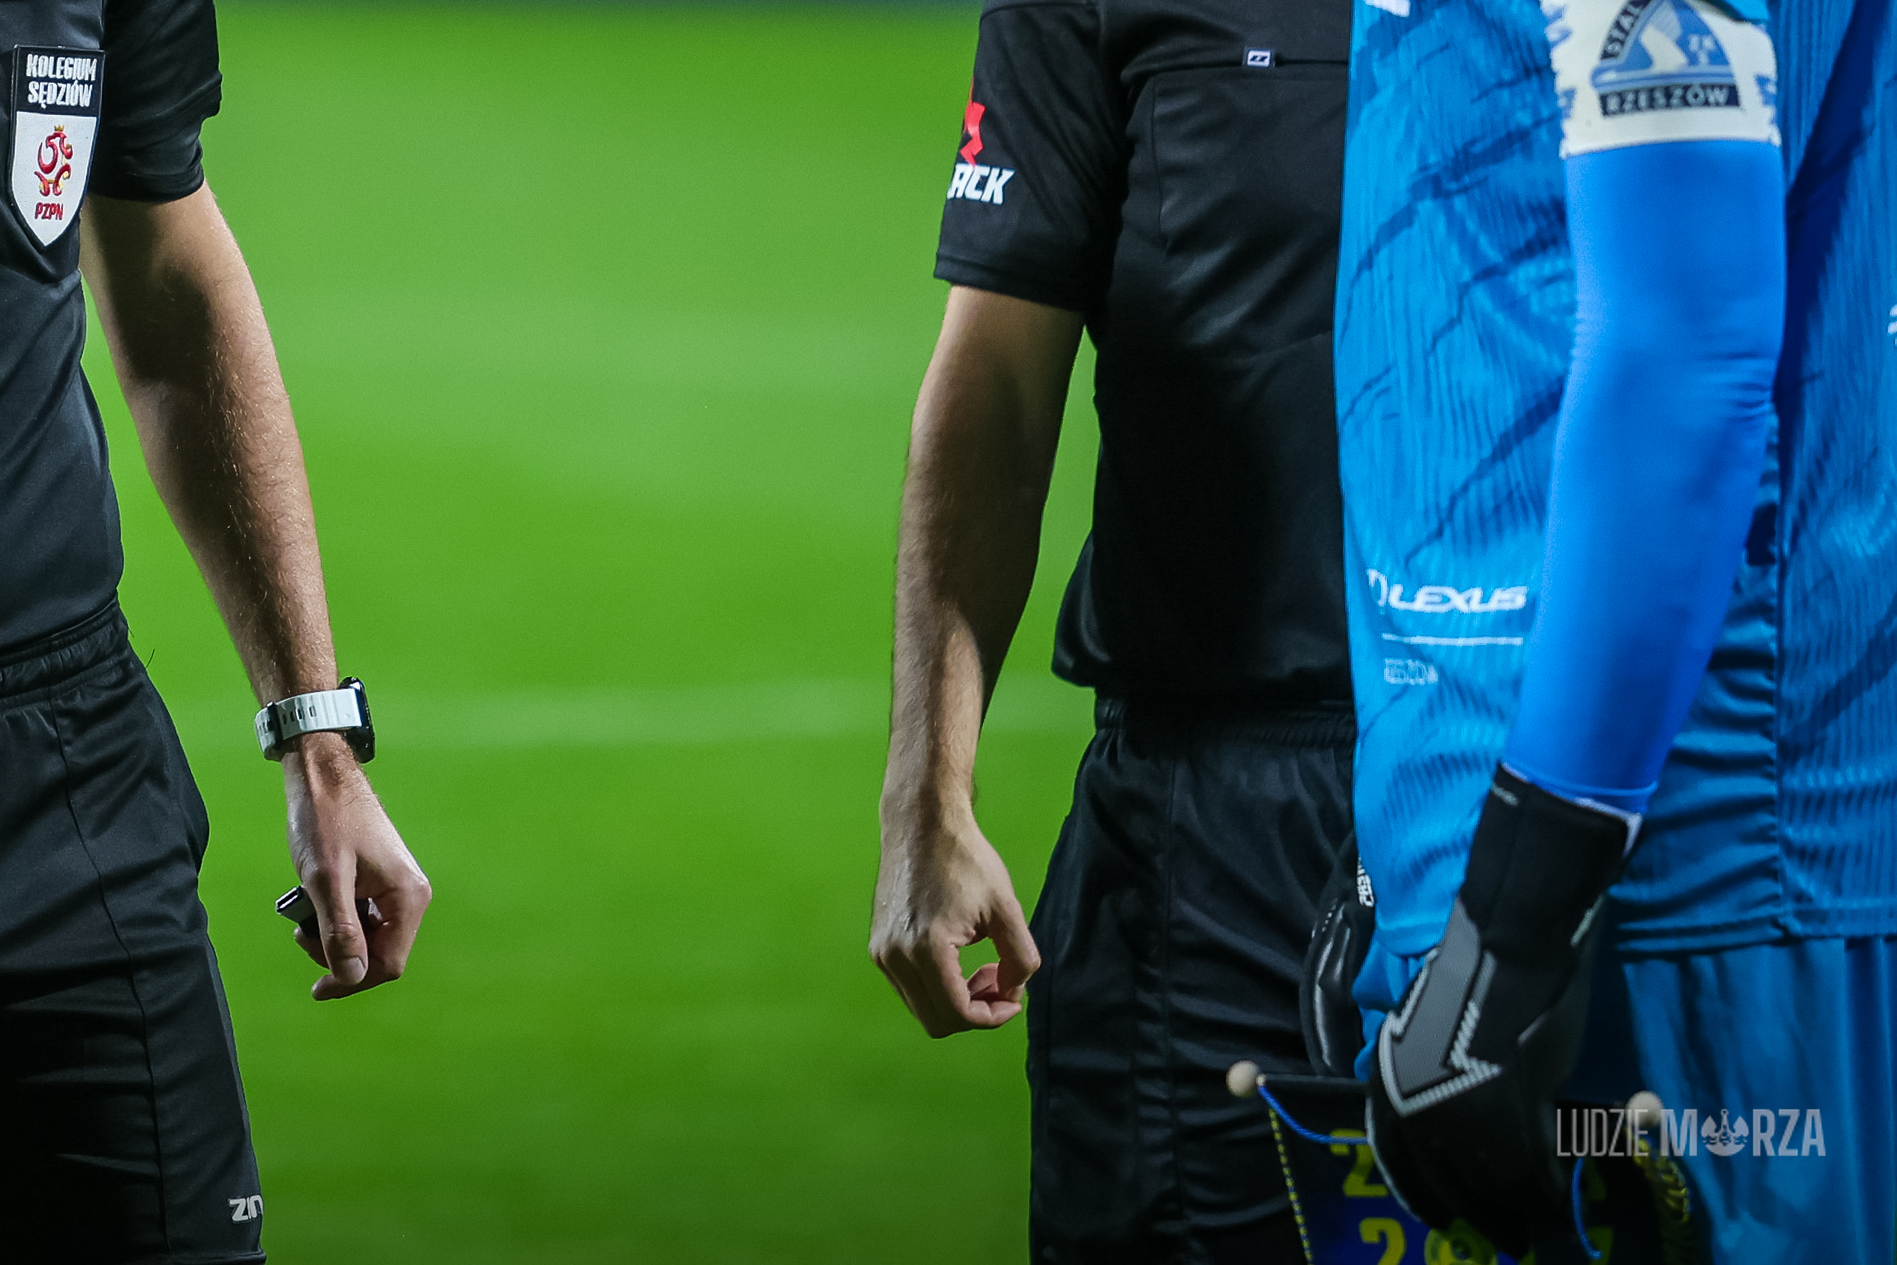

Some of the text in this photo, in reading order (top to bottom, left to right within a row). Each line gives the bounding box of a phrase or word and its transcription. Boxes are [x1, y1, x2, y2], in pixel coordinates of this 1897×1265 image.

[25, 53, 98, 81] KOLEGIUM
[27, 79, 93, 110] SĘDZIÓW
[1605, 84, 1730, 114] RZESZÓW
[946, 162, 1016, 206] ACK
[34, 202, 64, 221] PZPN
[1388, 583, 1529, 614] LEXUS
[228, 1194, 264, 1224] zin
